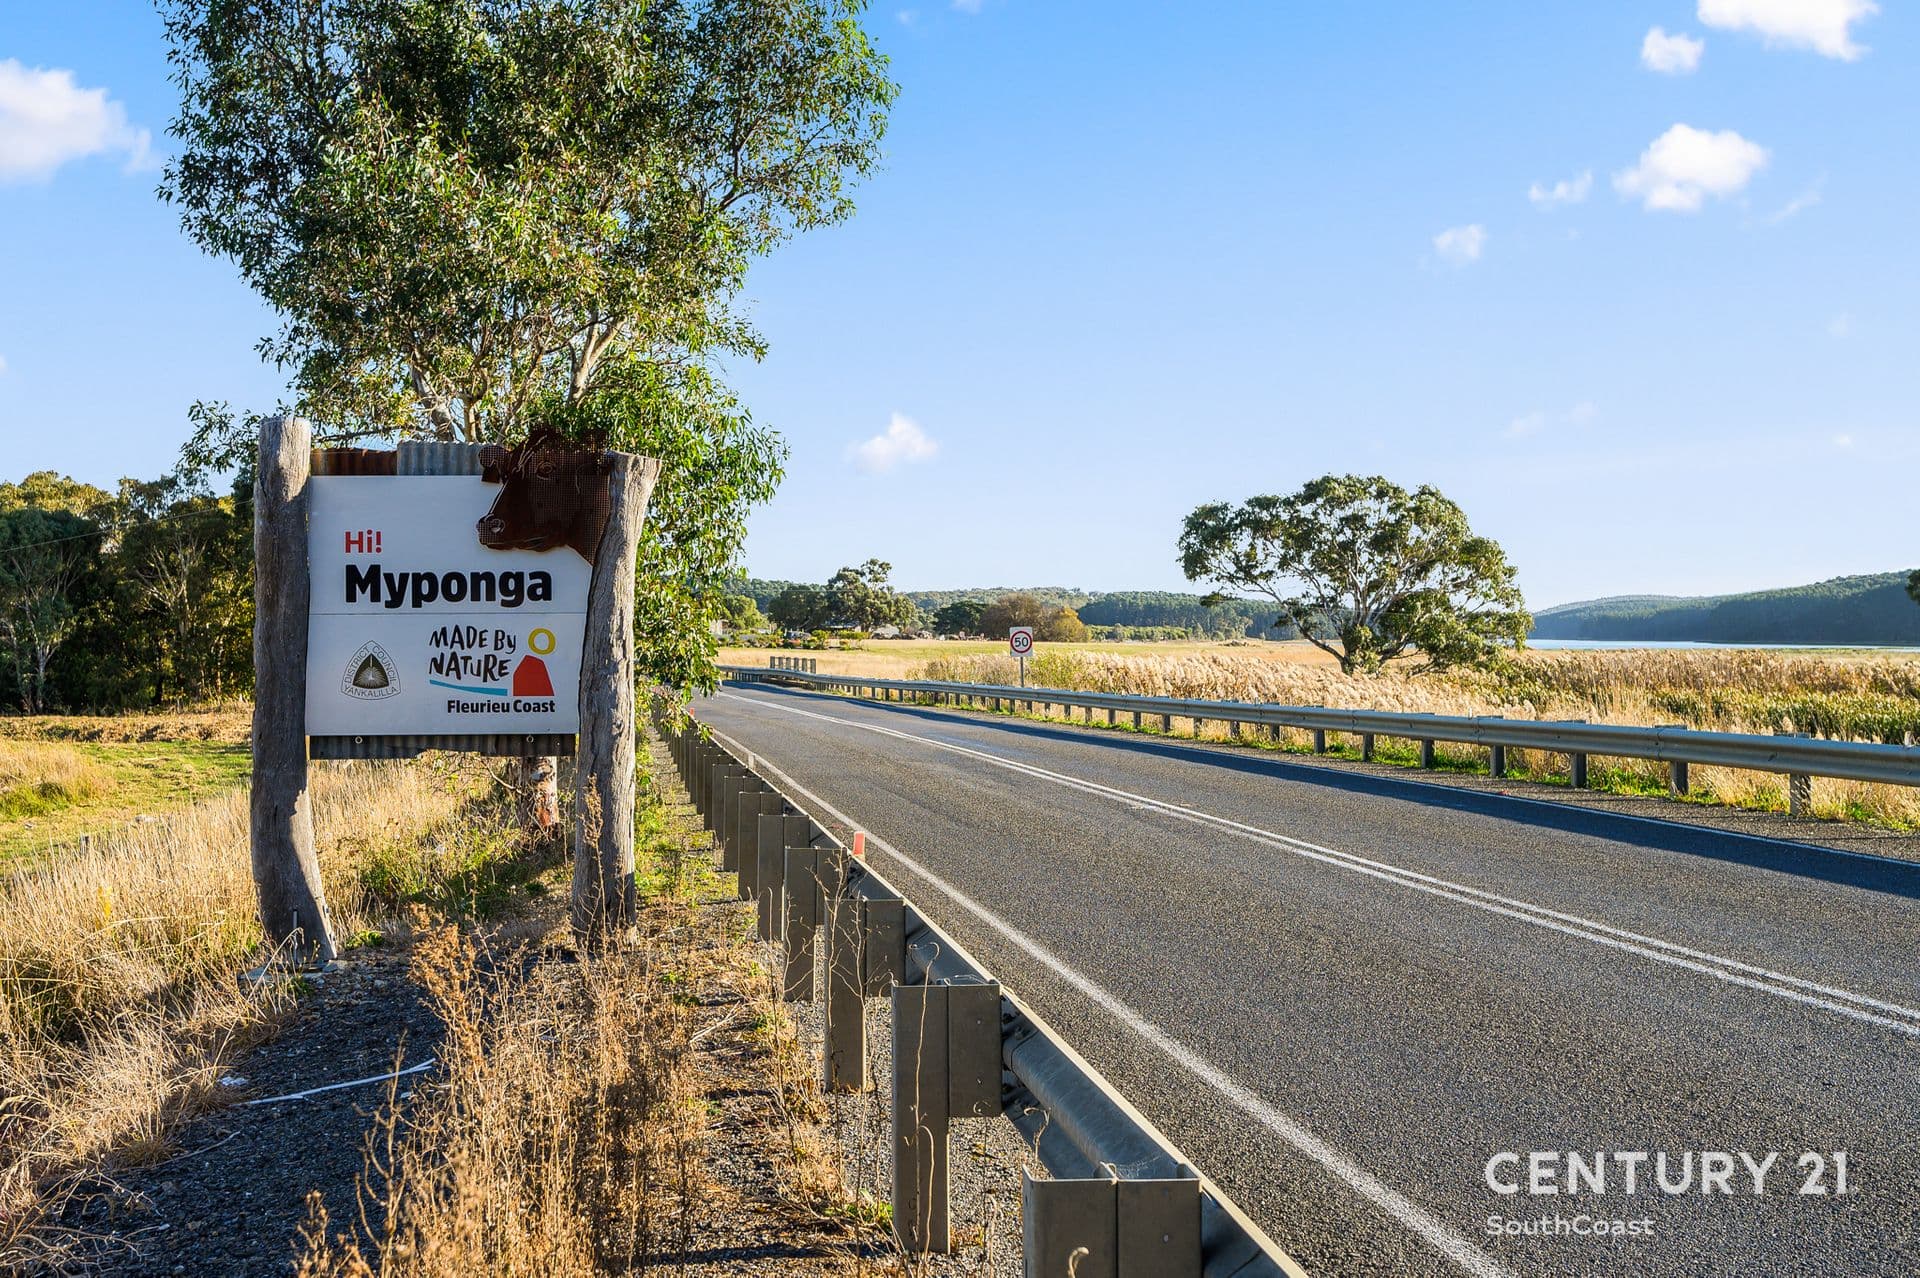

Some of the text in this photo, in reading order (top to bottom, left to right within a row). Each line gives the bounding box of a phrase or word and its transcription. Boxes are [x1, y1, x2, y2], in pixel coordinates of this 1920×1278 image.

[345, 529, 382, 553] Hi!
[345, 564, 552, 608] Myponga
[429, 625, 488, 651] MADE
[1014, 636, 1029, 647] 50
[344, 645, 397, 684] DISTRICT COUNCIL
[429, 651, 511, 683] NATURE
[447, 700, 556, 713] Fleurieu Coast
